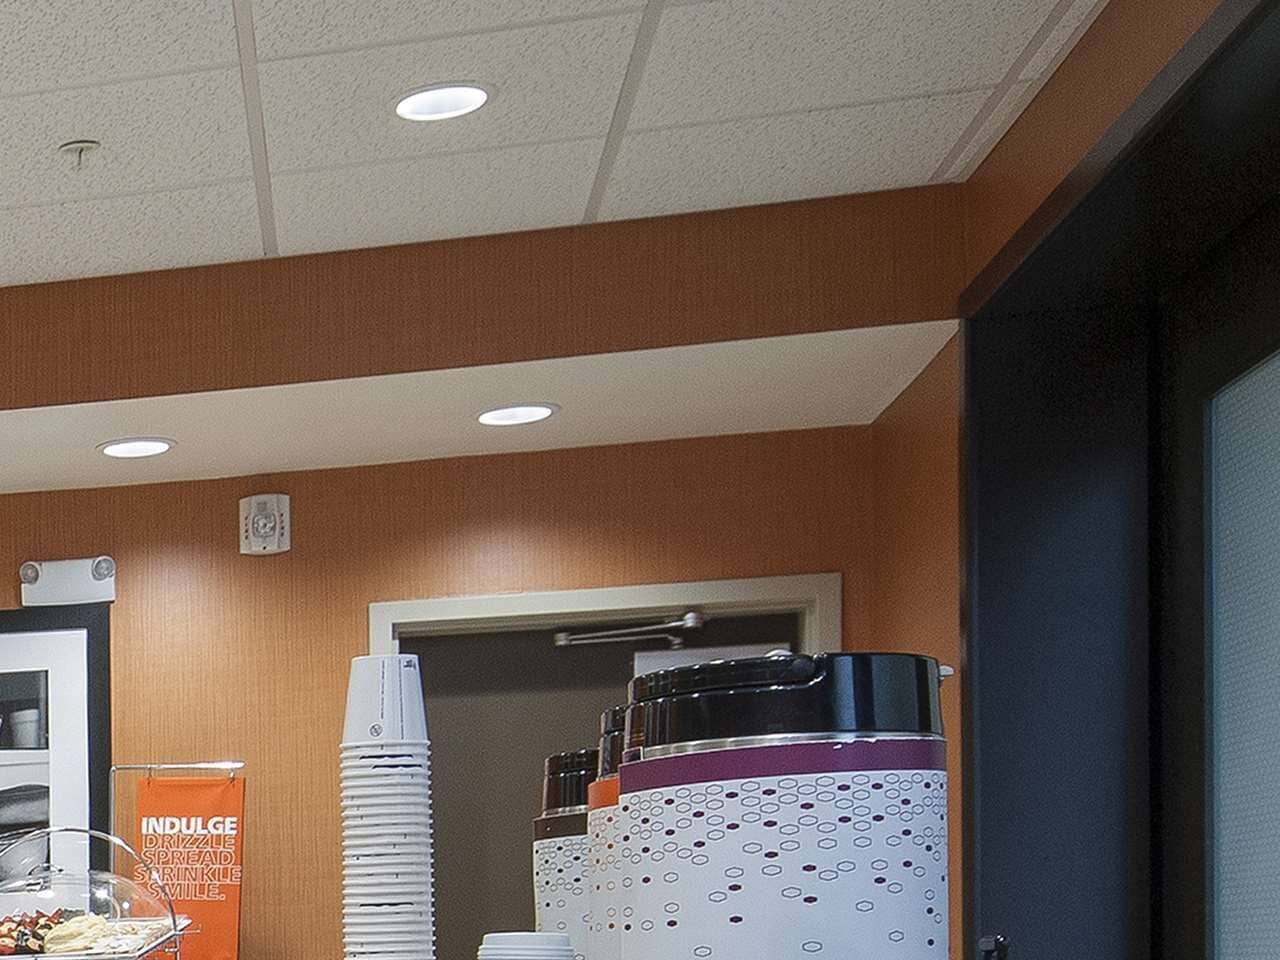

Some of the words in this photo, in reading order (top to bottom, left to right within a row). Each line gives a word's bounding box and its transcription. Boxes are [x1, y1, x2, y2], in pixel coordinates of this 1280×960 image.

[141, 816, 238, 834] INDULGE
[143, 833, 235, 851] DRIZZLE
[142, 848, 236, 866] SPREAD
